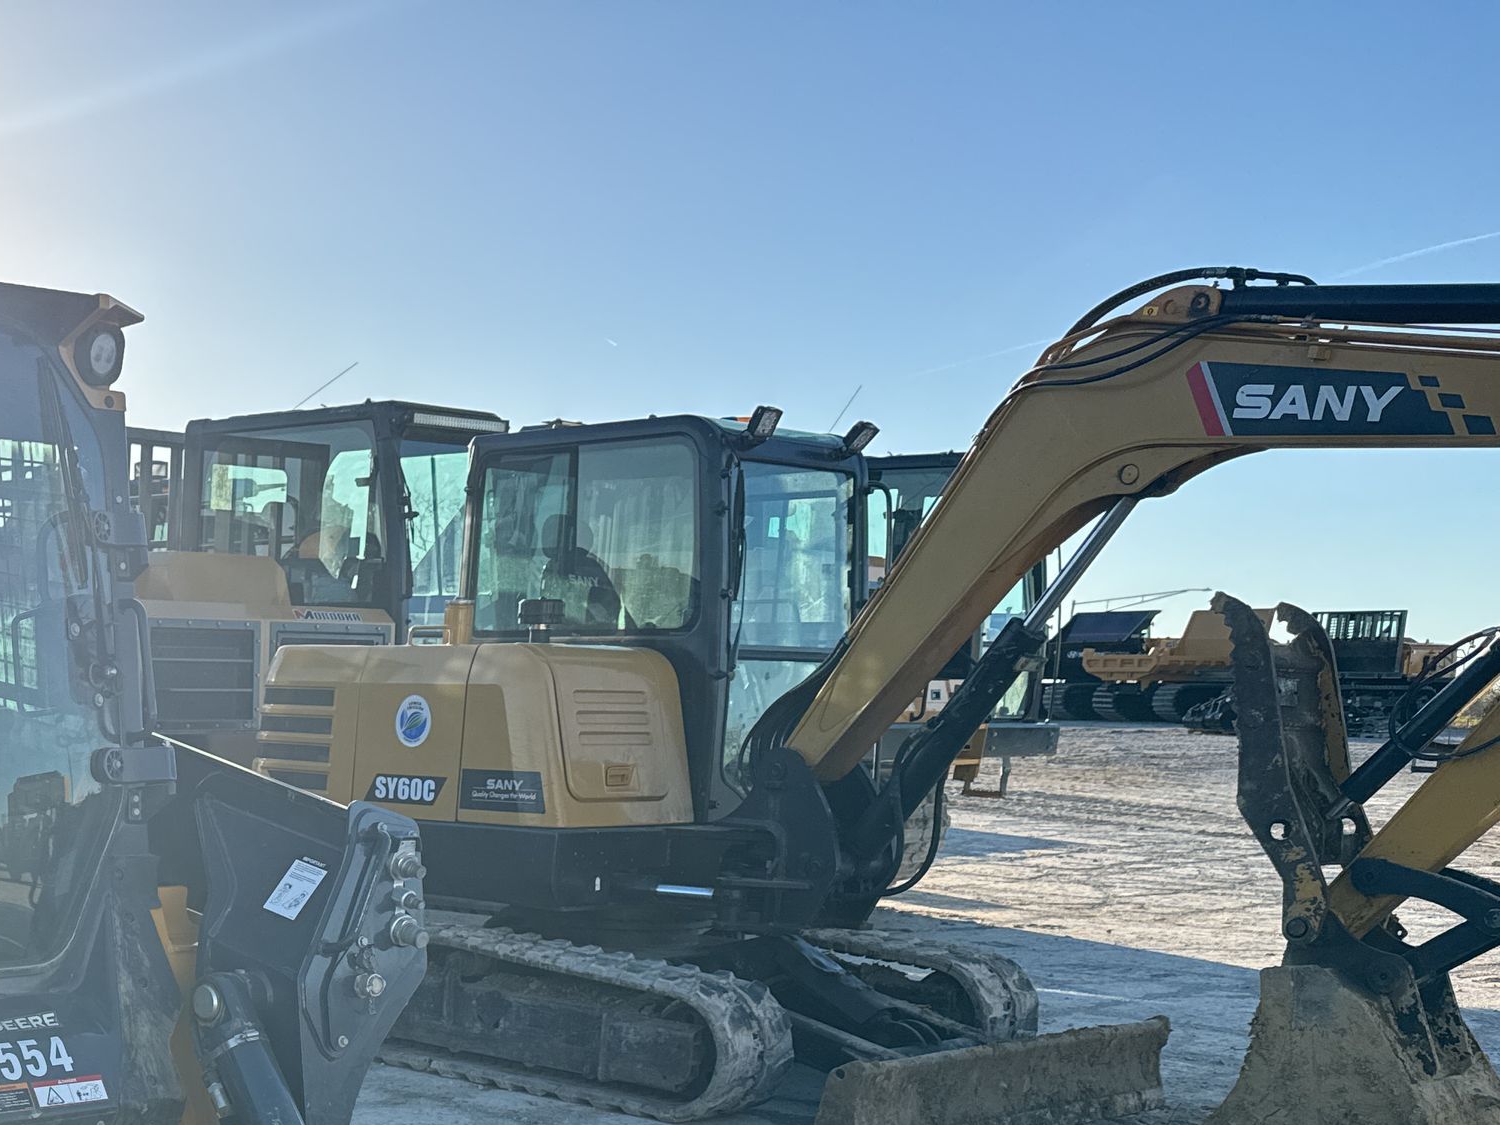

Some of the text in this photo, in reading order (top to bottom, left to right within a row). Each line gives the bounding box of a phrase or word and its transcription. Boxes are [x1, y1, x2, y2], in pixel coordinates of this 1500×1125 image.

[1232, 384, 1405, 422] SANY
[374, 775, 437, 802] SY60C
[486, 778, 524, 791] SANY
